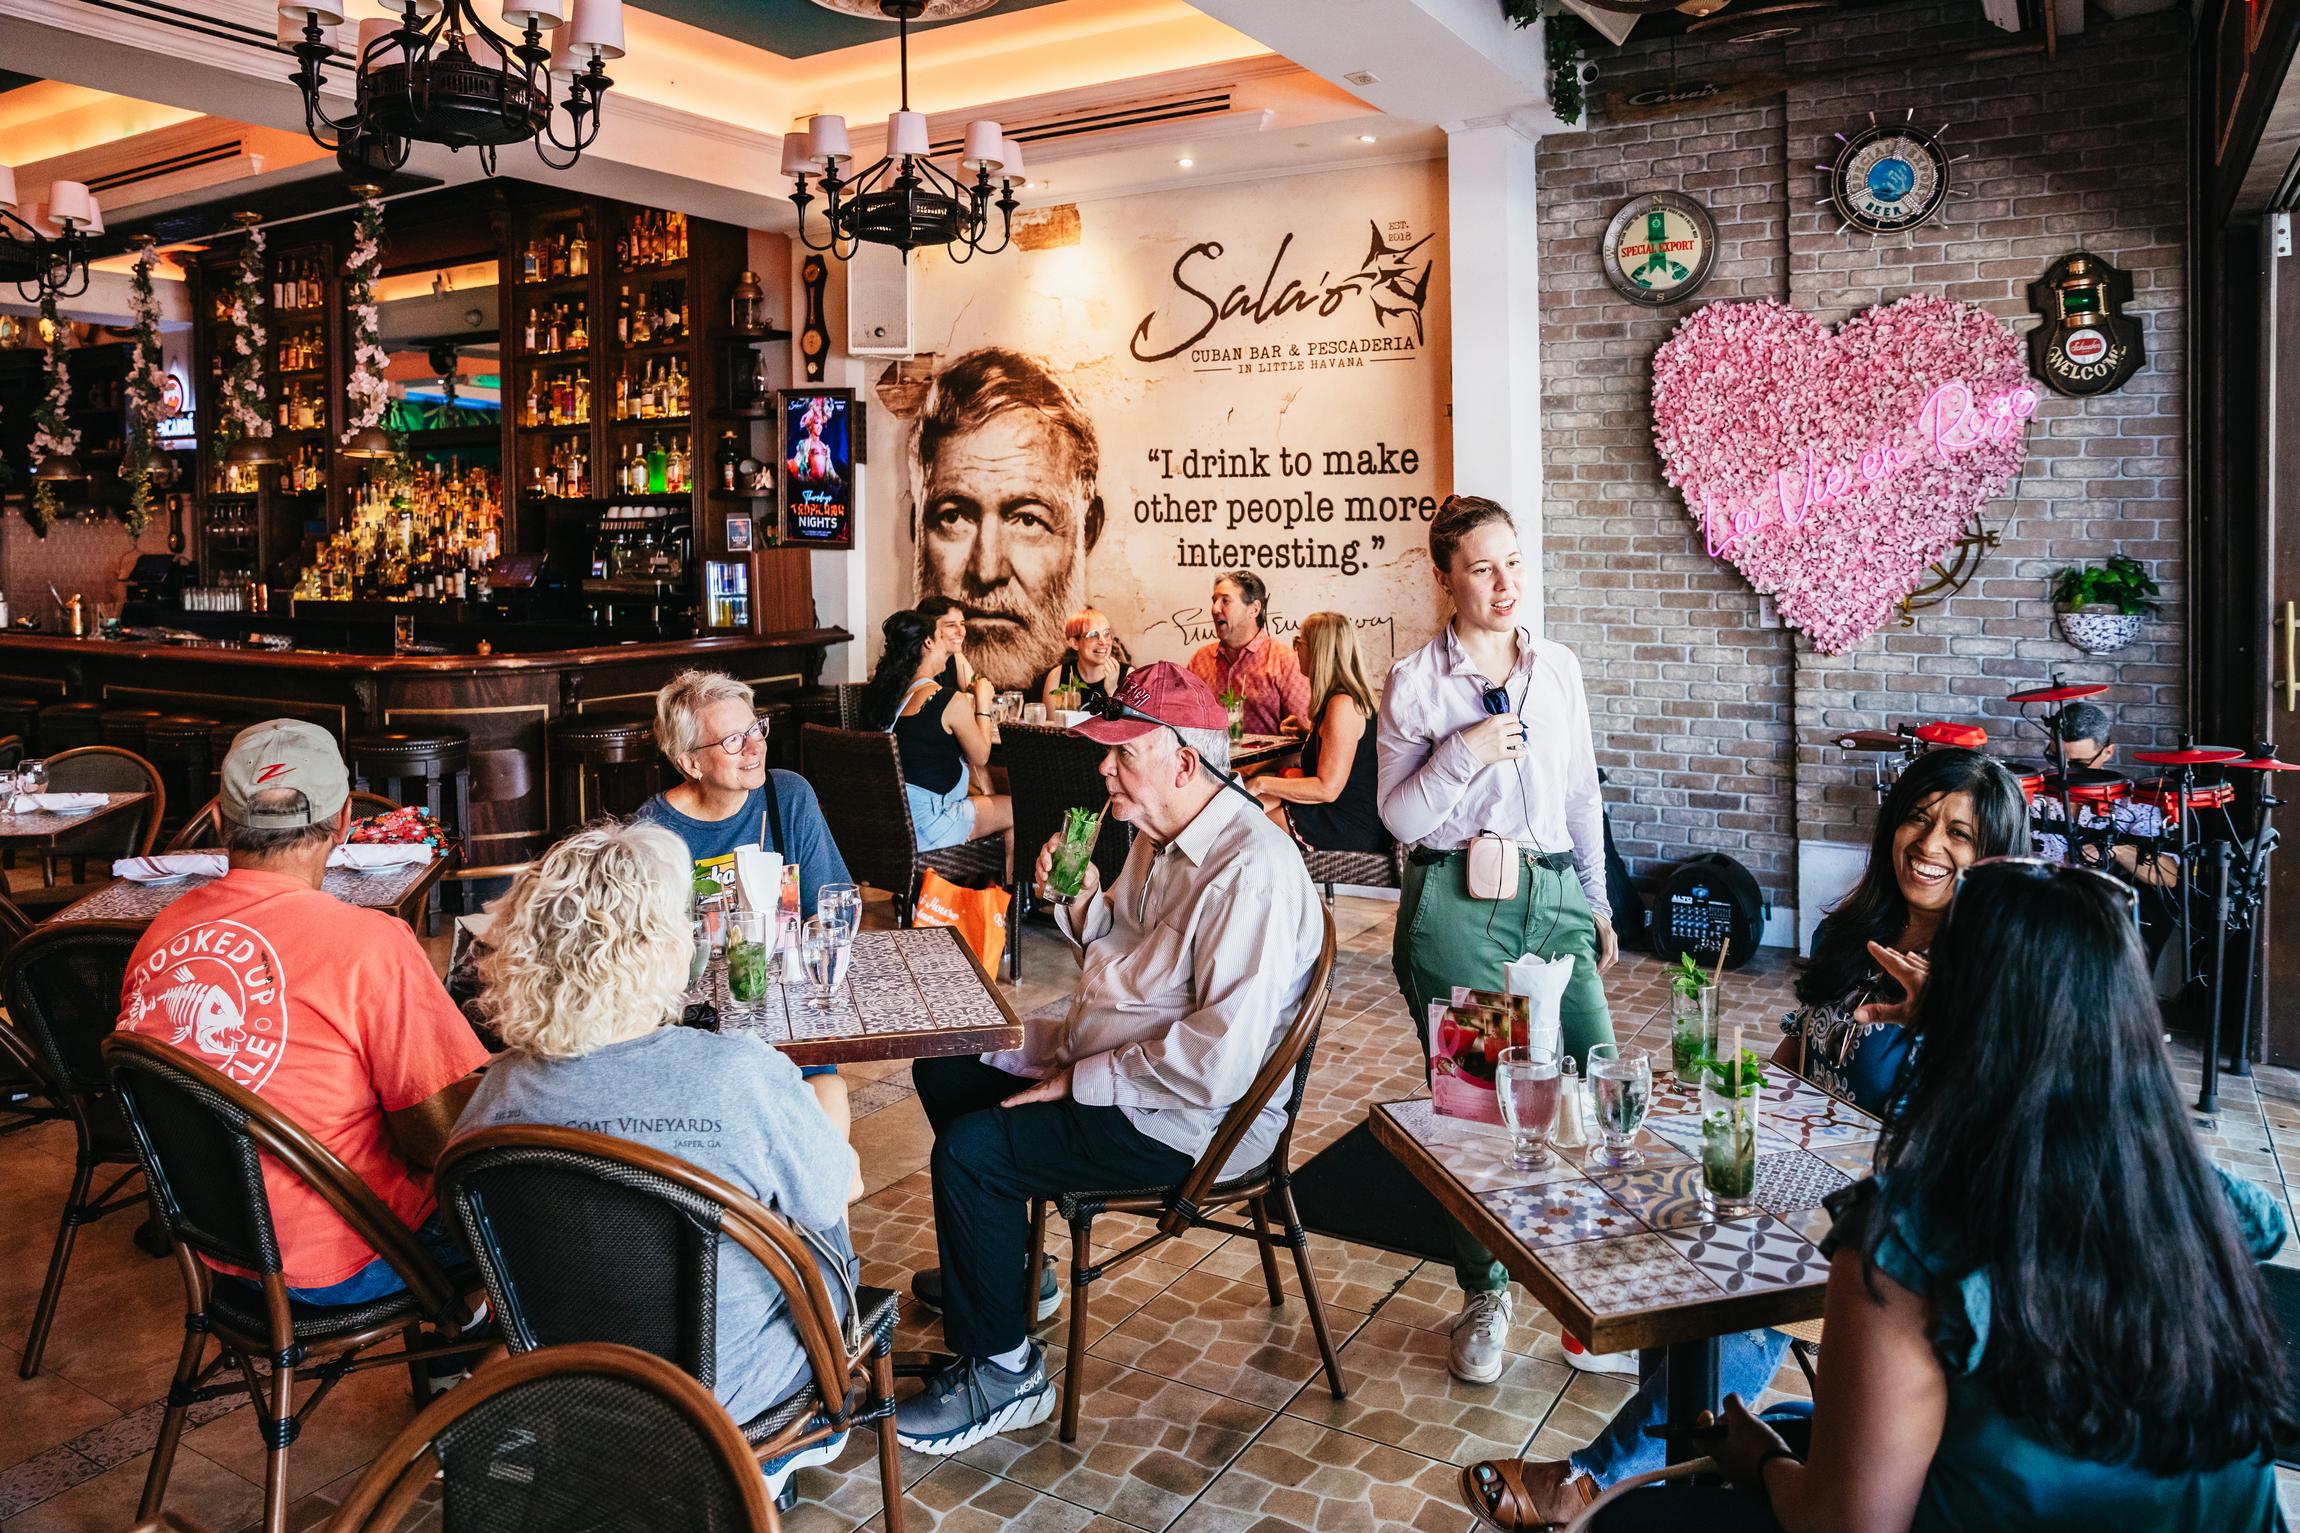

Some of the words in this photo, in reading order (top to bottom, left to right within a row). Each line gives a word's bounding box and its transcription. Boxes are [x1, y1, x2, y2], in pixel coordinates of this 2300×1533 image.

[1905, 146, 1931, 200] EXPORT
[1865, 201, 1903, 217] BEER
[1387, 220, 1410, 231] EST.
[1387, 231, 1412, 242] 2018
[1621, 244, 1656, 258] SPECIAL
[1659, 240, 1695, 252] EXPORT
[1191, 347, 1243, 363] CUBAN
[1249, 345, 1282, 360] BAR
[1288, 343, 1301, 356] &
[1307, 336, 1416, 356] PESCADERIA
[1237, 364, 1252, 374] IN
[1258, 361, 1305, 373] LITTLE
[1310, 357, 1364, 370] HAVANA
[1181, 446, 1271, 479] drink
[1279, 447, 1312, 478] to
[1322, 442, 1419, 476] make
[1133, 493, 1218, 524] other
[1226, 491, 1335, 530] people
[1344, 494, 1438, 522] more
[1705, 494, 1761, 558] La
[1777, 450, 1848, 527] Vie
[1862, 447, 1910, 481] en
[798, 515, 839, 529] NIGHTS
[1671, 894, 1693, 904] ALTO
[244, 963, 276, 1005] UP
[617, 1117, 722, 1133] VINEYARDS
[707, 1139, 721, 1149] GA
[1014, 1369, 1043, 1397] HOKA
